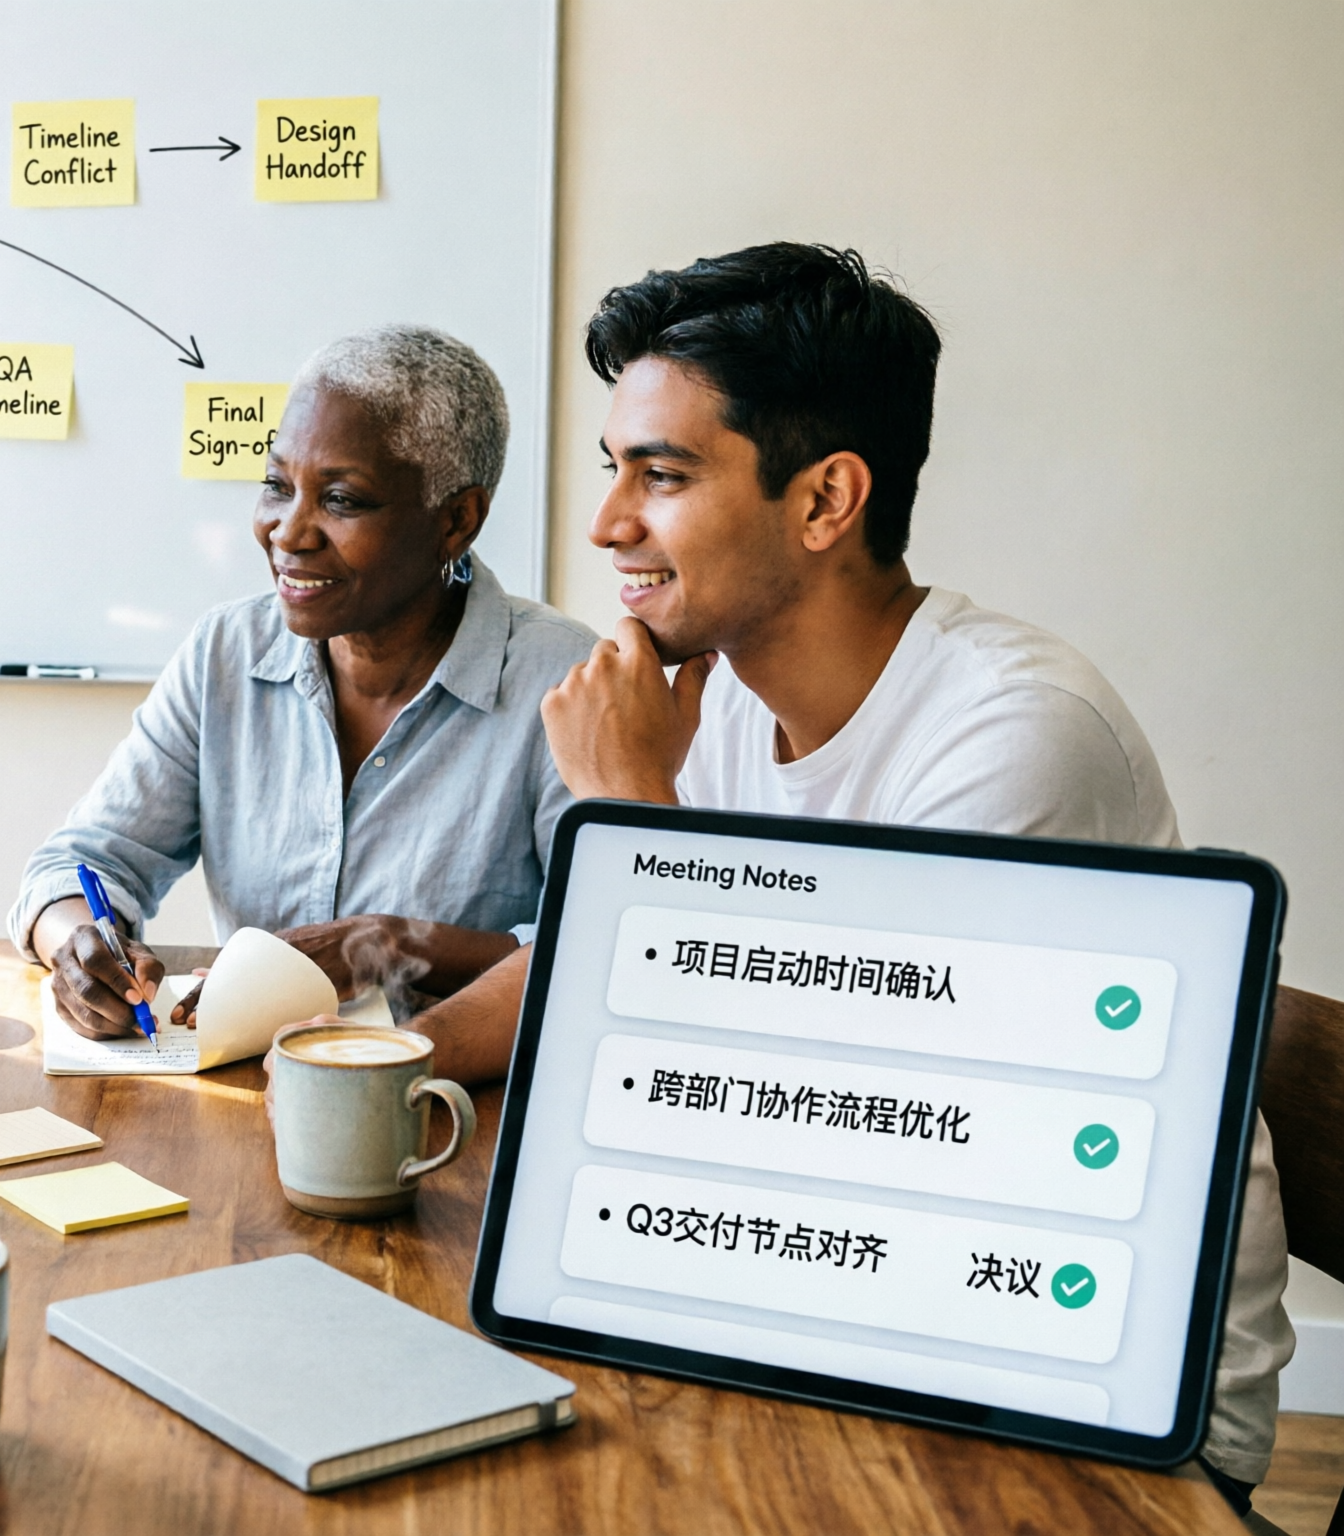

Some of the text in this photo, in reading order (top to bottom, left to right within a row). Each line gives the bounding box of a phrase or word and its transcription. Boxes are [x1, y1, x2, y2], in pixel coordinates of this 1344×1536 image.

[19, 123, 120, 149] Timeline
[276, 116, 356, 152] Design
[24, 157, 117, 186] Conflict
[266, 151, 367, 180] Handoff
[208, 396, 264, 423] Final
[188, 429, 278, 467] Sign-of
[633, 853, 817, 893] Meeting Notes
[671, 939, 957, 1004] 项目启动时间确认
[647, 1069, 972, 1144] 跨部门协作流程优化
[626, 1203, 1042, 1299] Q3交付节点对齐 决议
